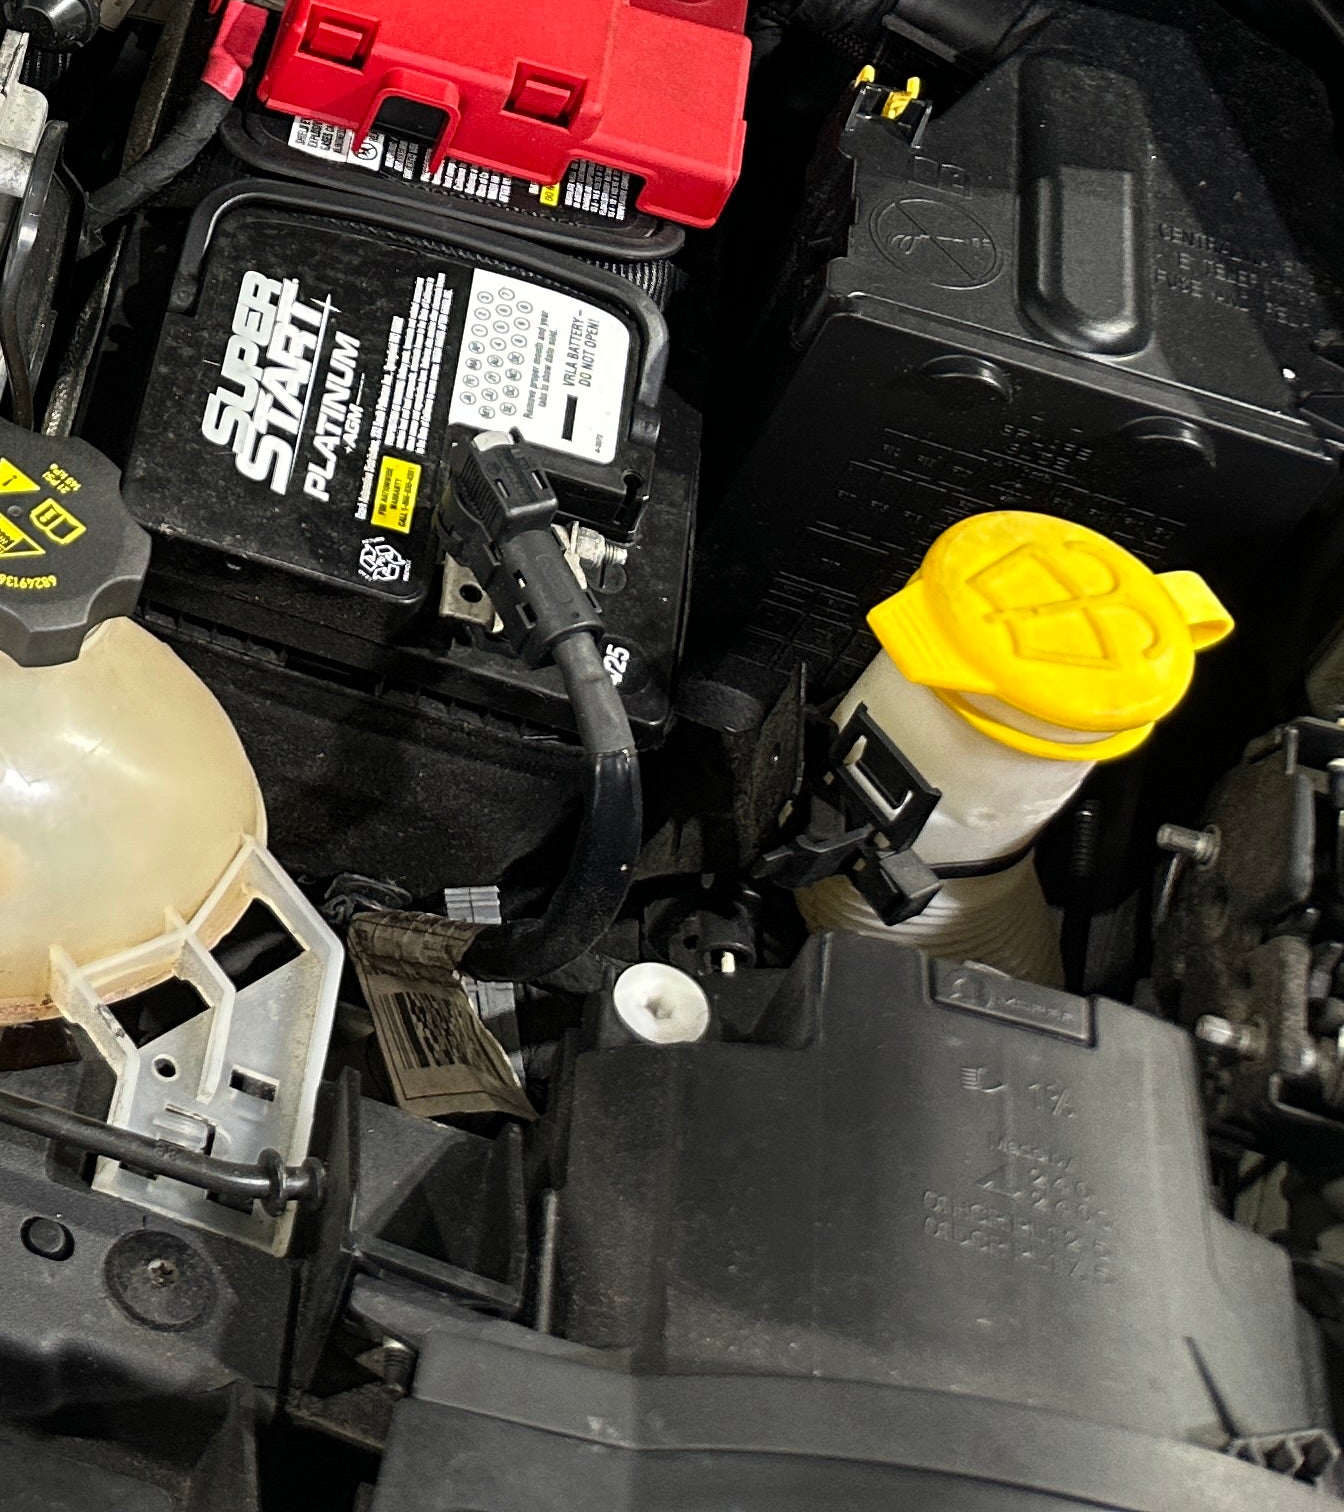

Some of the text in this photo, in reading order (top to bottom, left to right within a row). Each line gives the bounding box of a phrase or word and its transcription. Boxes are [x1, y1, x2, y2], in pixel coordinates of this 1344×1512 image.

[201, 270, 284, 454] SUPER
[567, 316, 585, 360] BATTERY
[578, 318, 600, 387] DO NOT OPEN!
[235, 278, 324, 495] START
[562, 362, 578, 387] VRLA
[303, 331, 361, 503] PLATINUM
[344, 402, 364, 449] AGM
